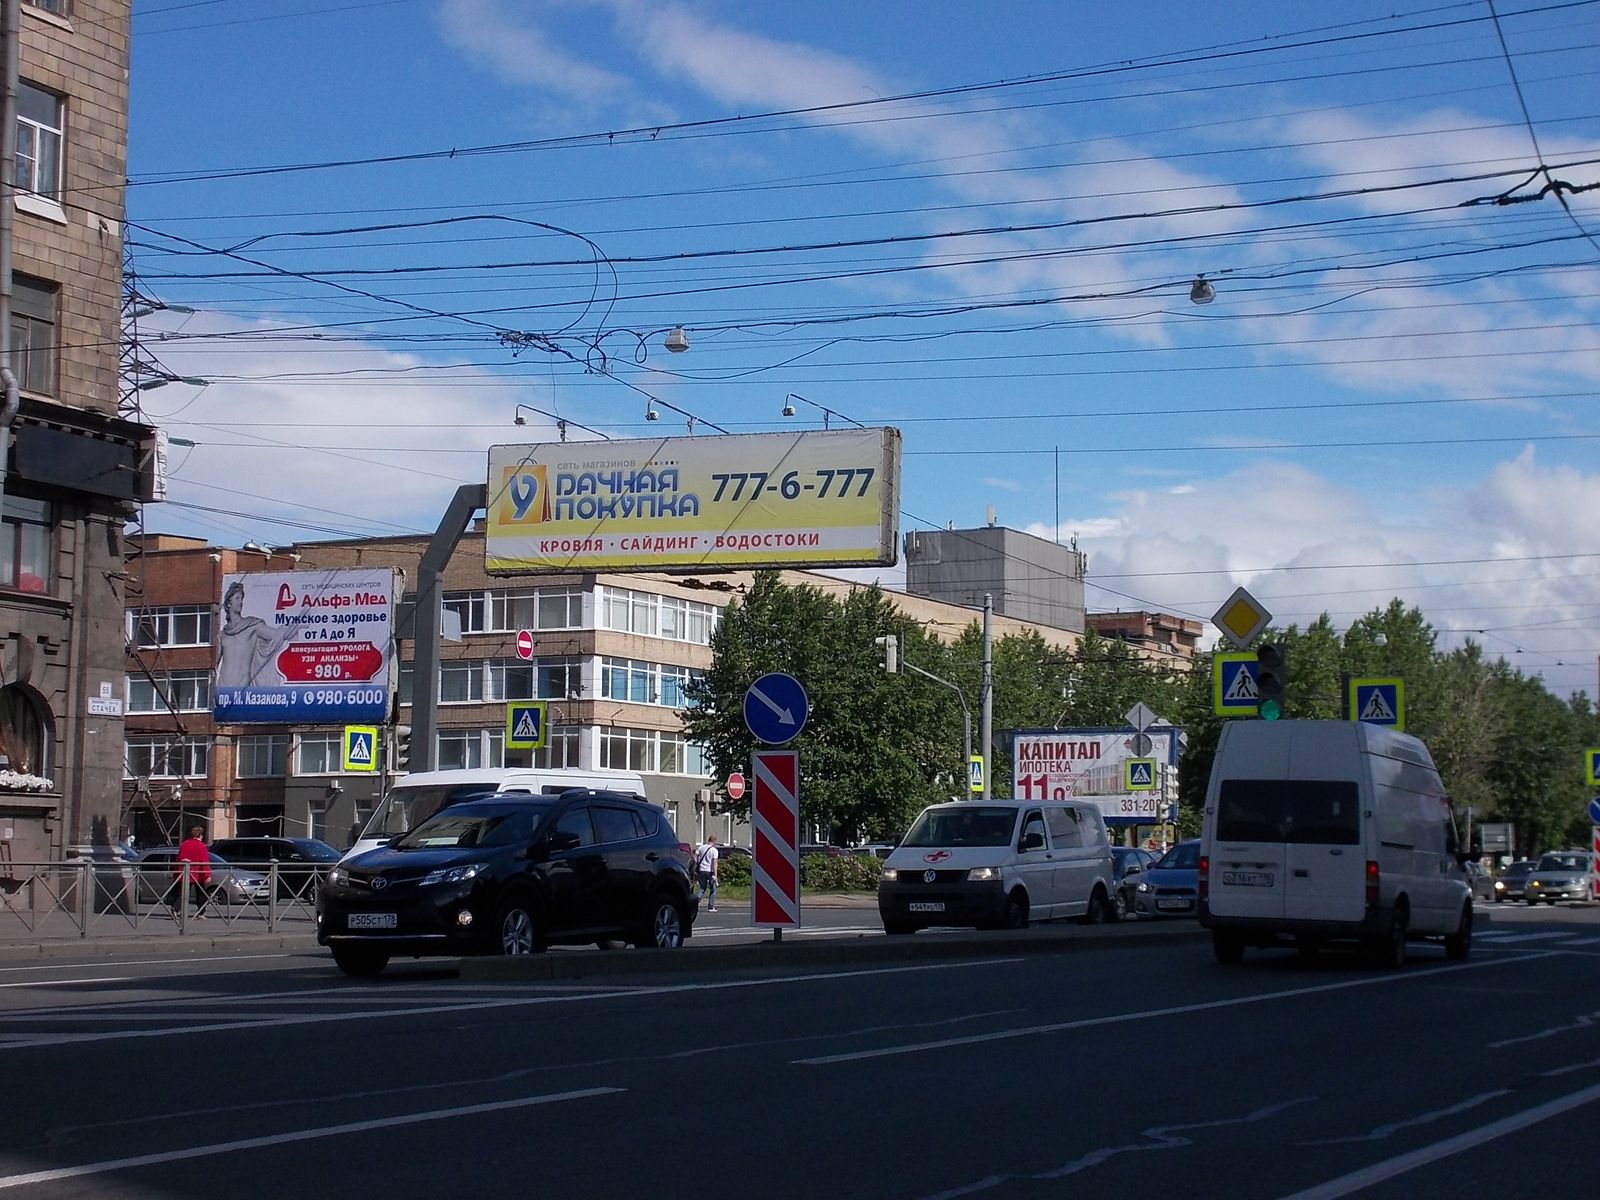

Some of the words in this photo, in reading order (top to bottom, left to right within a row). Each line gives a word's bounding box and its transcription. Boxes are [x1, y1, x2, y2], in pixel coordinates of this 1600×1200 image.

[557, 462, 580, 470] сеть
[582, 459, 636, 470] магазинов
[556, 469, 679, 496] ДАЧНАЯ
[712, 468, 875, 501] 777-6-777
[555, 492, 700, 520] ПОКУПКА
[540, 538, 604, 553] КРОВЛЯ
[620, 534, 698, 552] САЙДИНГ
[715, 532, 819, 550] ВОДОСТОКИ
[275, 613, 328, 626] Мужское
[331, 612, 387, 625] здоровье
[304, 630, 317, 640] от
[320, 628, 328, 639] А
[330, 630, 345, 640] до
[347, 627, 356, 639] Я
[339, 644, 371, 652] УРОЛОГА
[314, 664, 341, 678] 980
[218, 693, 231, 708] пр.
[245, 690, 289, 708] Казакова,
[291, 690, 297, 705] 9
[1019, 741, 1101, 760] КАПИТАЛ
